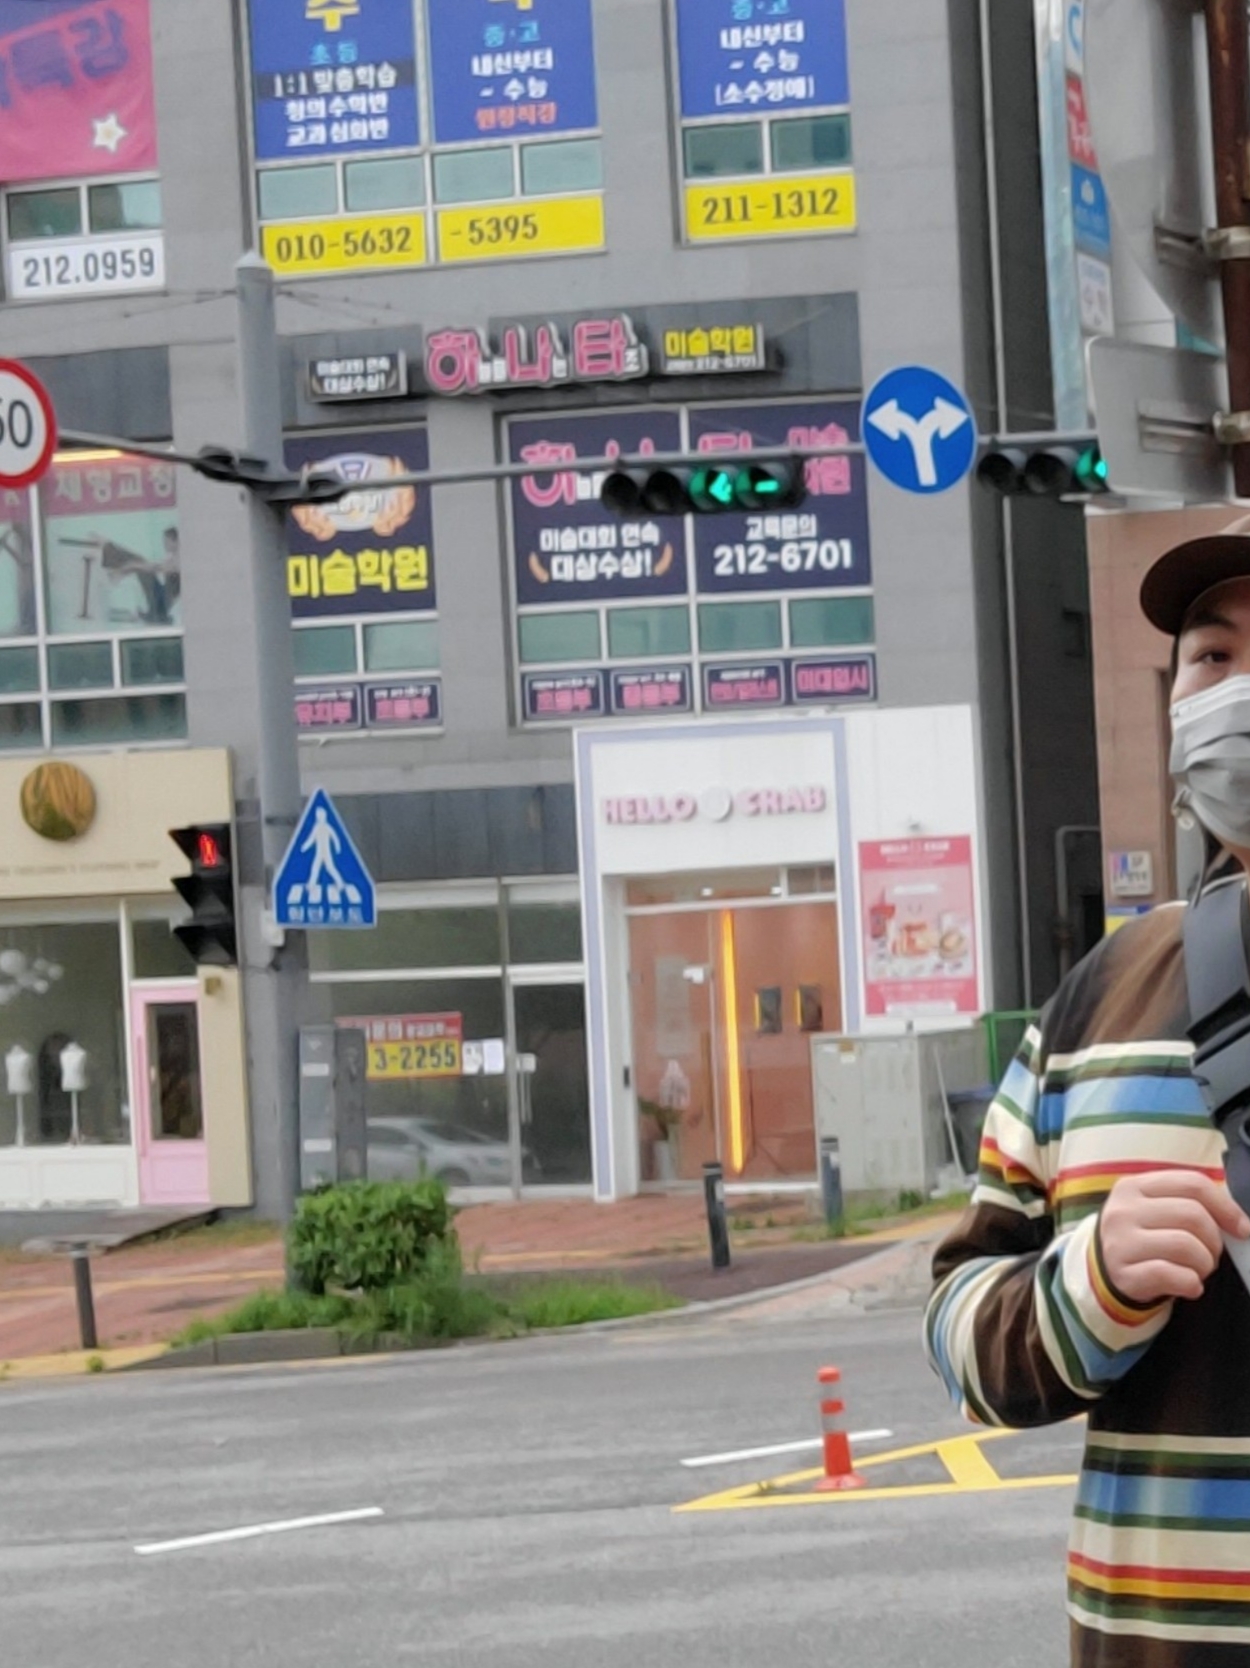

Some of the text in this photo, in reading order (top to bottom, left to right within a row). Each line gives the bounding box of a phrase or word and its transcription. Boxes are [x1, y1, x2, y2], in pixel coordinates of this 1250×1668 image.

[720, 20, 804, 49] 내신부터
[471, 47, 553, 76] 내신부터
[753, 49, 799, 73] 수능
[313, 62, 397, 94] 맞춤학습
[503, 76, 548, 101] 수능
[715, 75, 815, 106] (소수정예)
[703, 189, 838, 224] 211-1312
[276, 227, 412, 262] 010-5632
[23, 248, 155, 288] 212.0959
[665, 326, 754, 358] 미술학원
[0, 398, 33, 449] 0
[540, 521, 660, 552] 미술대회 연속
[746, 515, 817, 541] 교육문의
[287, 545, 428, 599] 미술학원
[551, 551, 652, 582] 대상수상!
[714, 539, 853, 576] 212-6701
[605, 793, 698, 826] HELLO
